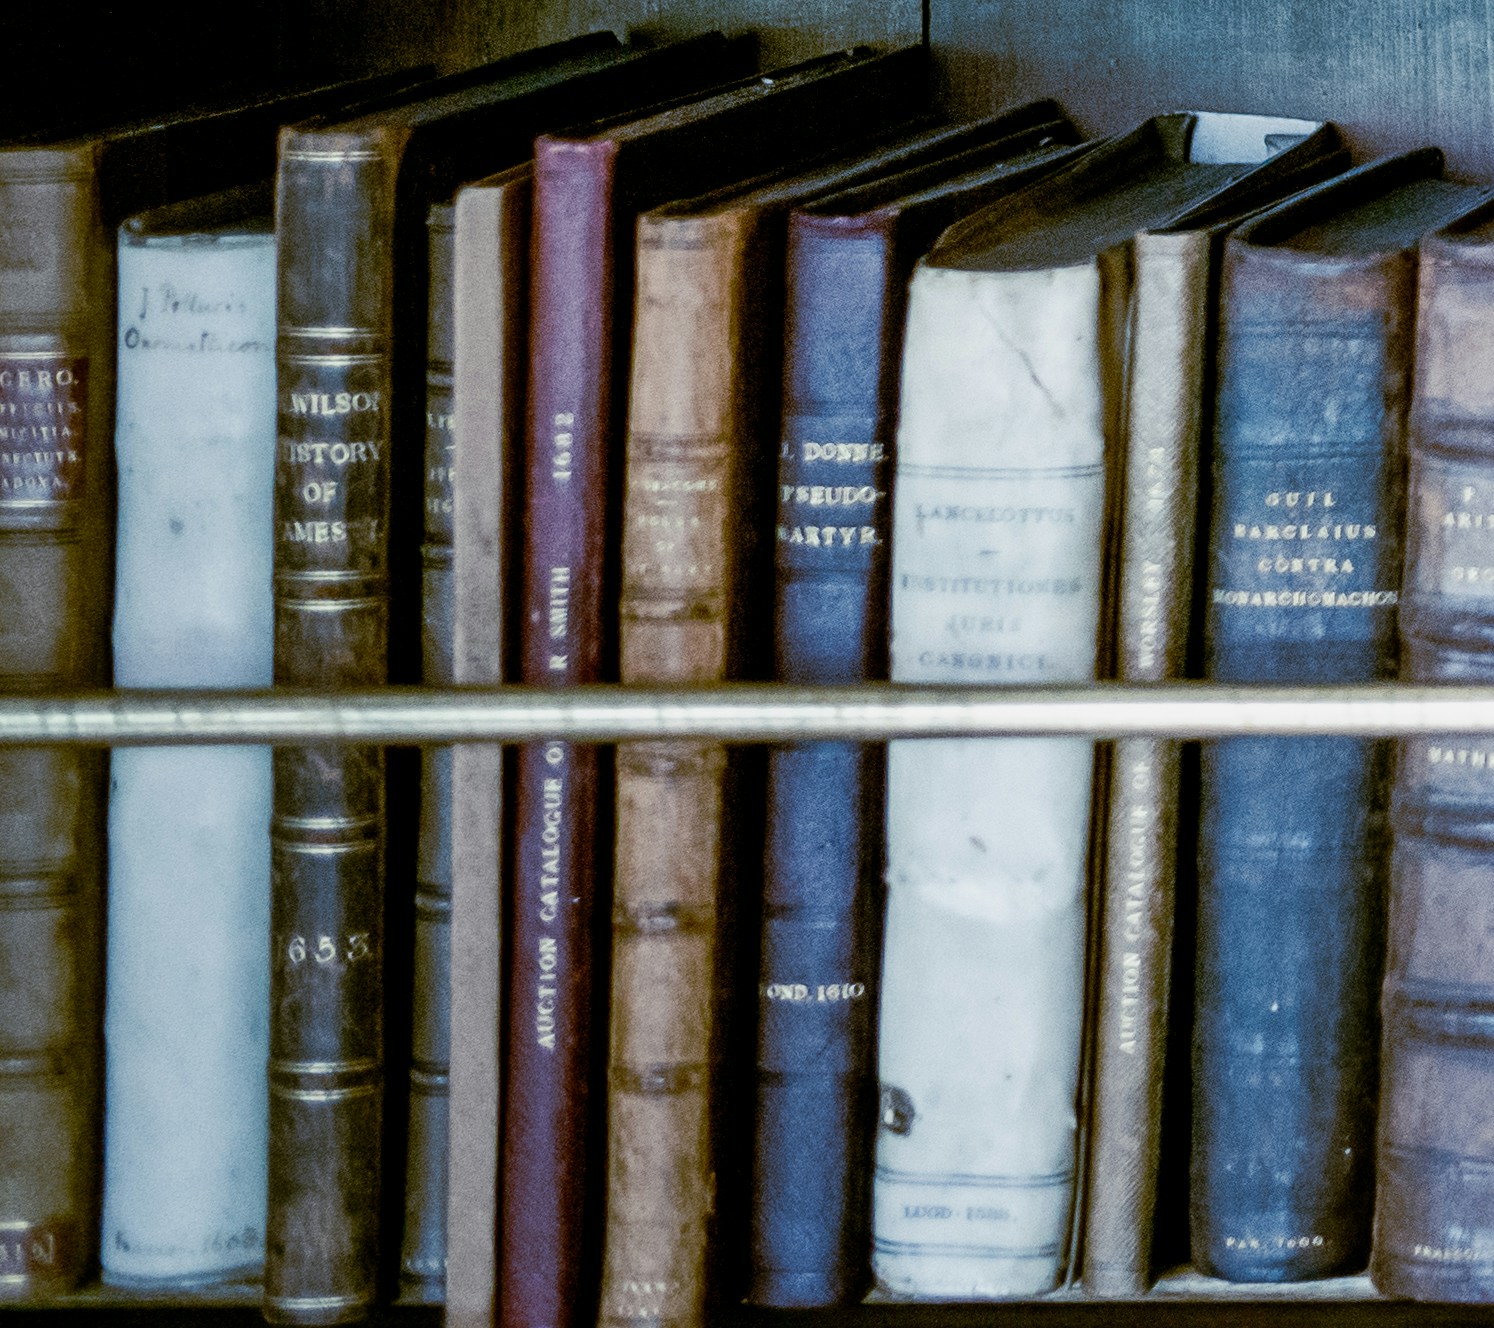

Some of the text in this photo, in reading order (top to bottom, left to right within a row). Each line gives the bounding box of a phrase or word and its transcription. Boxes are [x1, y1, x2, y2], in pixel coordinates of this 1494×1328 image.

[303, 481, 339, 503] OF
[1257, 558, 1354, 573] CONTRA
[549, 566, 572, 637] SMITH
[537, 777, 565, 1049] AUCTION CATALOGUE
[1118, 953, 1142, 1054] AUCTION
